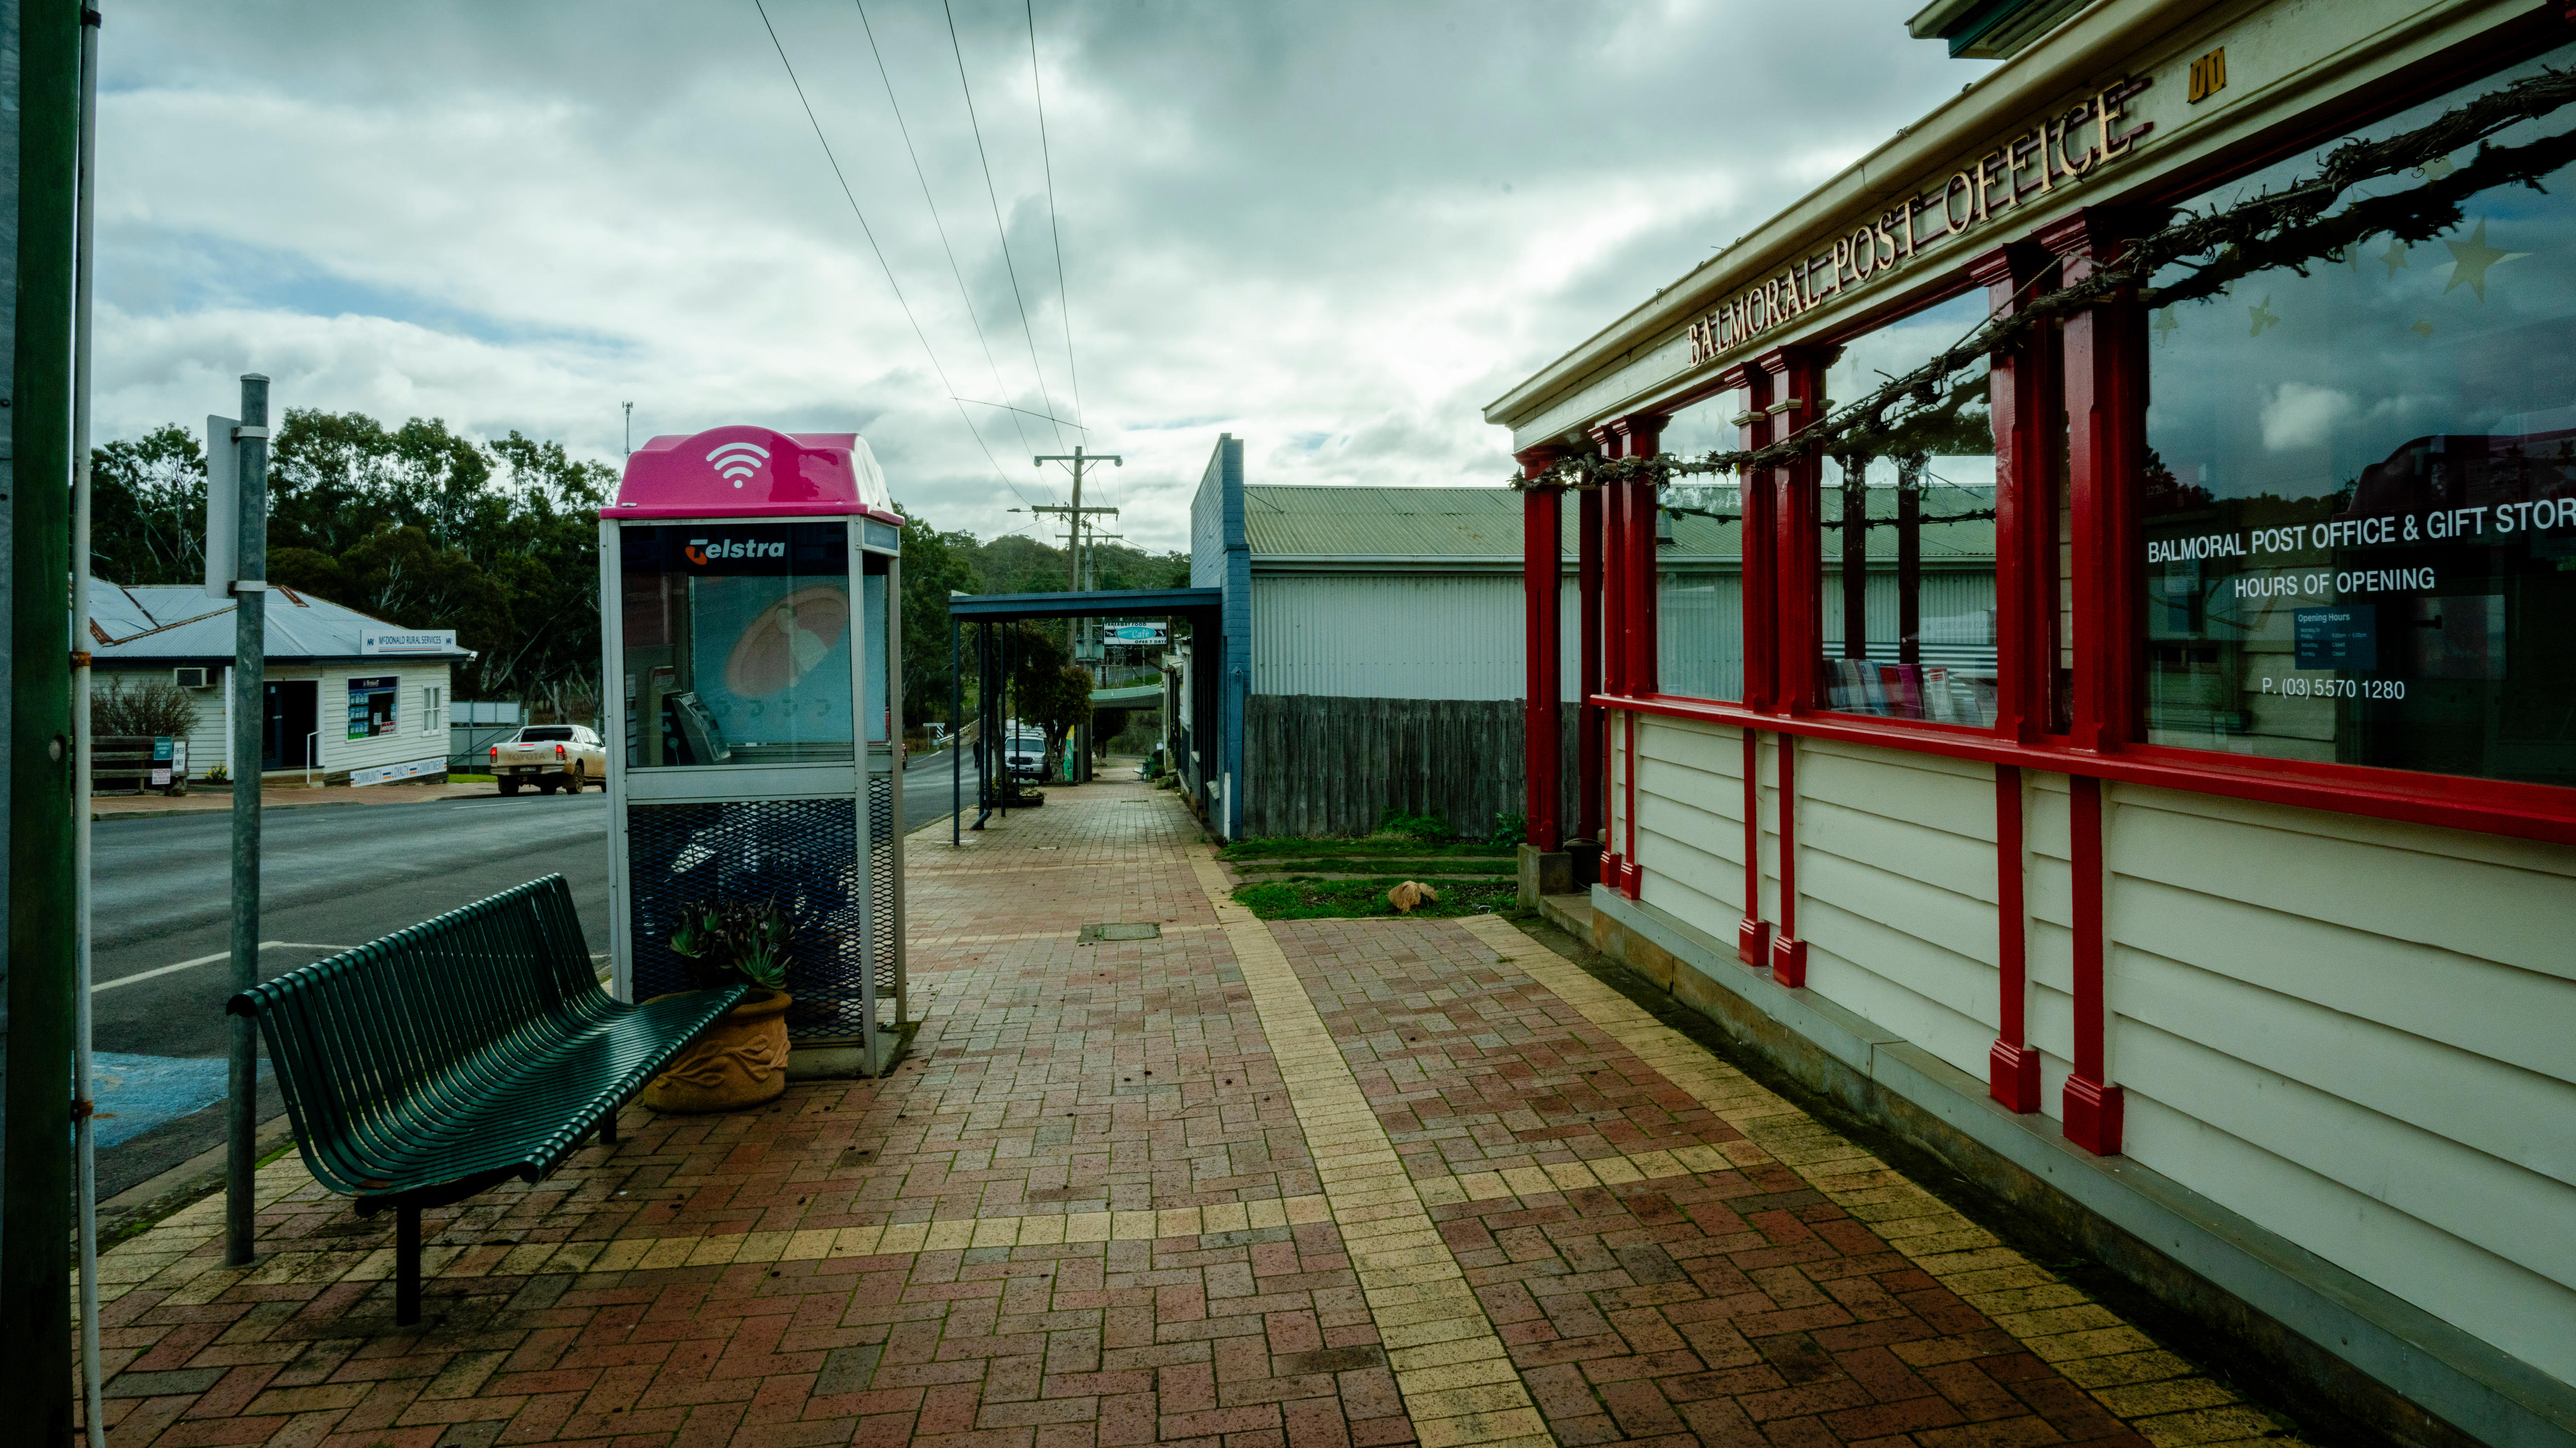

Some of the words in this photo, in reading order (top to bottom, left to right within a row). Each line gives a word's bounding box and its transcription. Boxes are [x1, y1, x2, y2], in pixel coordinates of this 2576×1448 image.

[1688, 256, 1822, 370] BALMORAL
[1832, 192, 1922, 294] POST
[1943, 76, 2133, 236] OFFICE
[2148, 533, 2246, 563] BALMORAL
[2251, 525, 2307, 555] POST
[2312, 516, 2395, 549] OFFICE
[2403, 514, 2419, 541] &
[2427, 507, 2487, 539] GIFT
[685, 538, 785, 565] Telstra
[2235, 575, 2298, 598] HOURS
[2304, 574, 2330, 594] OF
[2335, 567, 2435, 593] OPENING
[2298, 614, 2327, 623] Opening
[406, 636, 421, 644] RURAL
[422, 636, 441, 644] SERVICES
[1132, 629, 1149, 638] Café
[2282, 678, 2310, 700] (03)
[2314, 678, 2356, 697] 5570
[2362, 680, 2405, 699] 1280
[355, 770, 382, 785] COMMUNITY
[392, 765, 409, 778] LOYALTY
[417, 759, 444, 773] COMMITMENT
